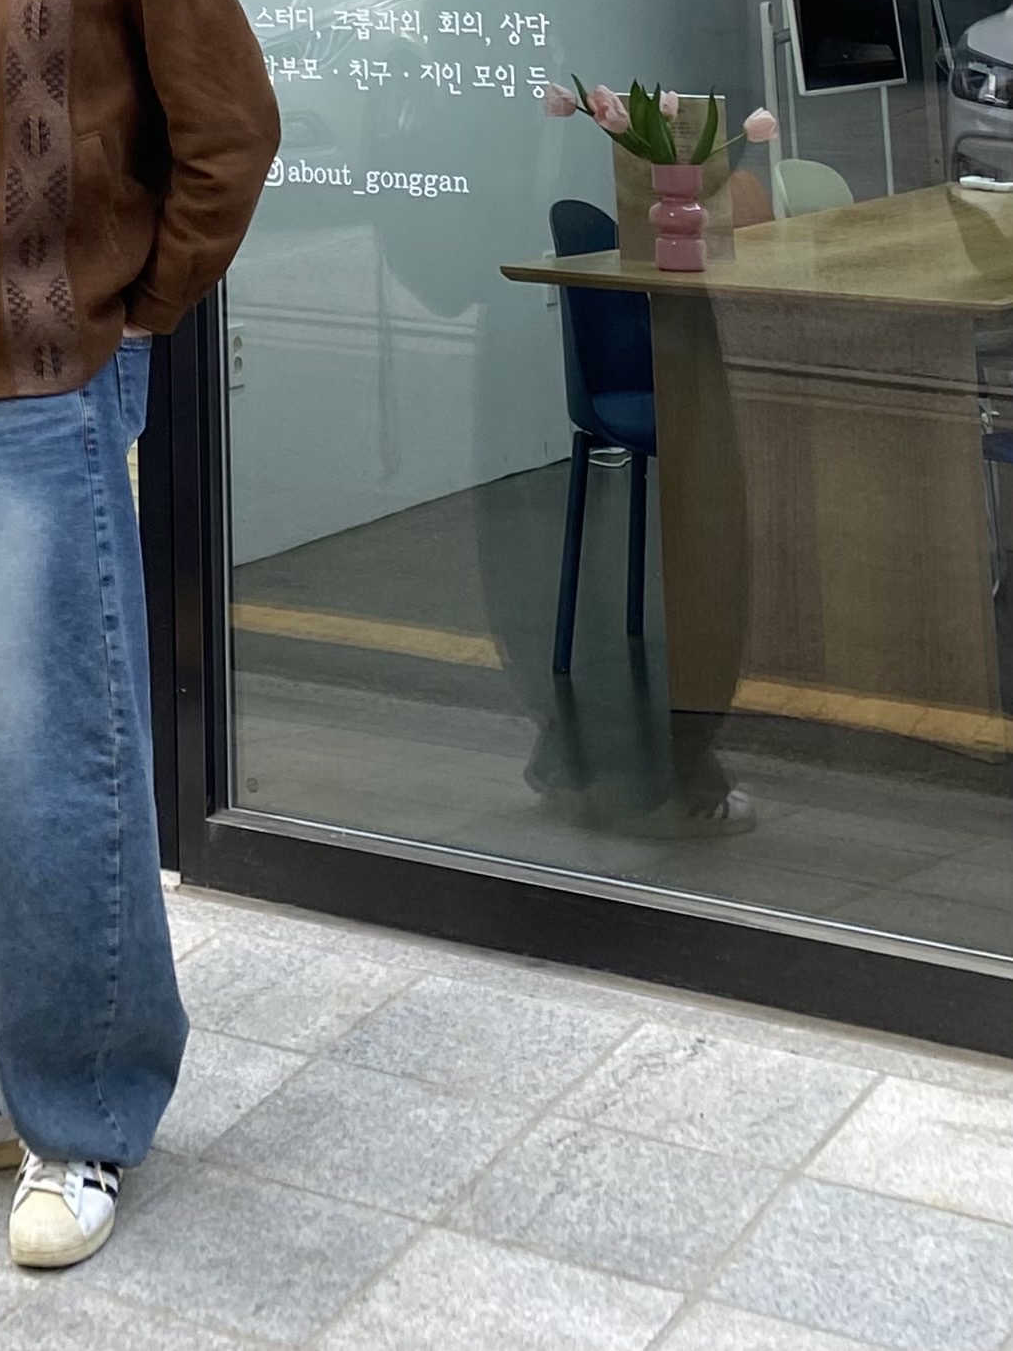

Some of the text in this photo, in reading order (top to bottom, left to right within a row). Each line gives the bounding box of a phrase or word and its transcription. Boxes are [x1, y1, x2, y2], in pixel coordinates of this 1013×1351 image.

[254, 6, 321, 40] 스터디,
[438, 10, 491, 46] 회의,
[499, 12, 550, 47] 상담
[349, 58, 392, 91] 친구
[420, 61, 462, 95] 지인
[472, 64, 515, 98] 모임
[526, 66, 550, 99] 등
[287, 159, 471, 198] about_gonggan
